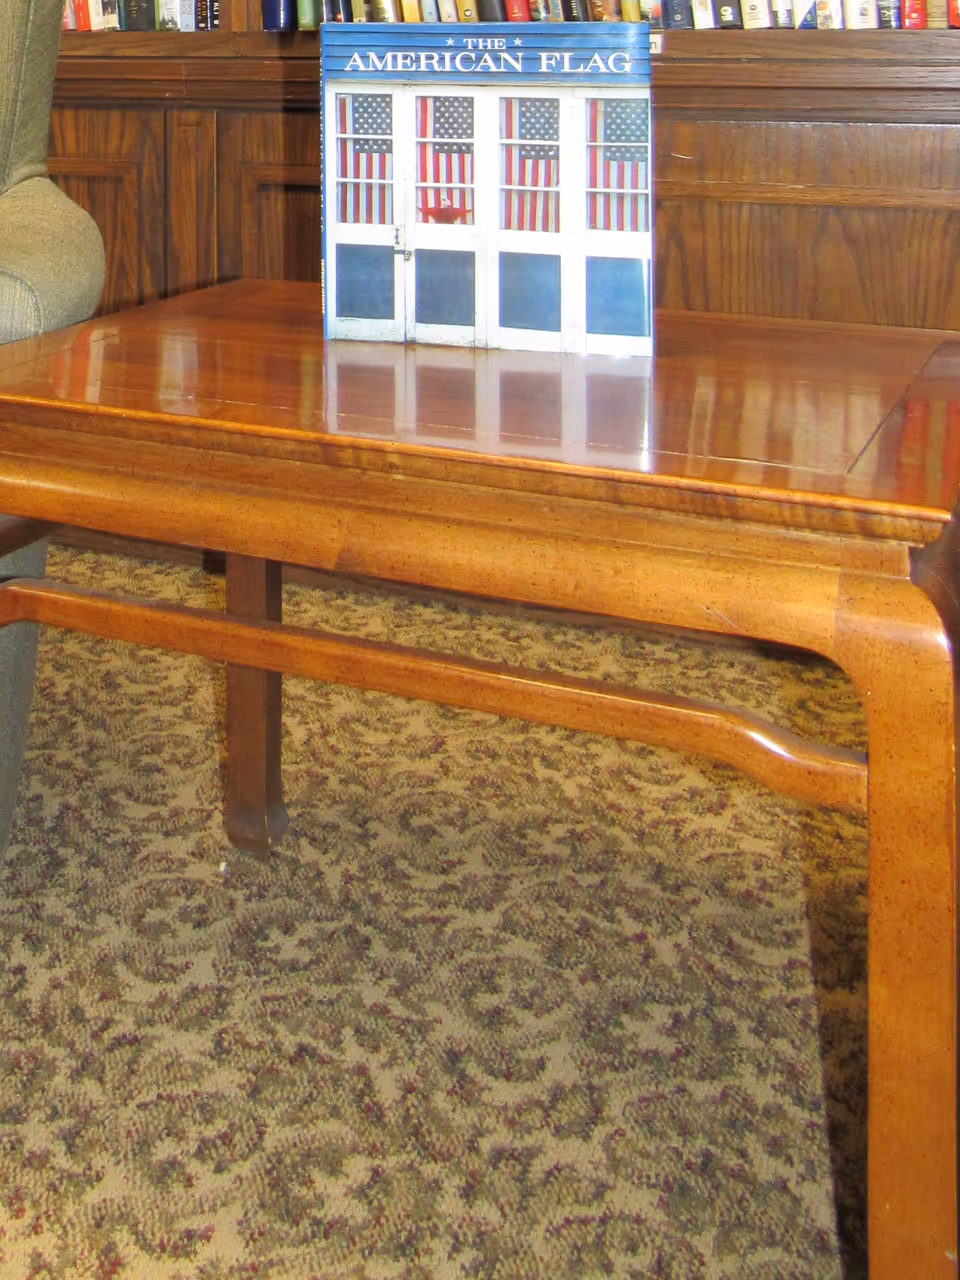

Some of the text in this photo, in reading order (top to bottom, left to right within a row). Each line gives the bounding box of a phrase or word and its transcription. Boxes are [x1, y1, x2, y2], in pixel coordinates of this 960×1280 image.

[462, 37, 507, 50] THE
[343, 51, 634, 74] AMERICAN FLAG
